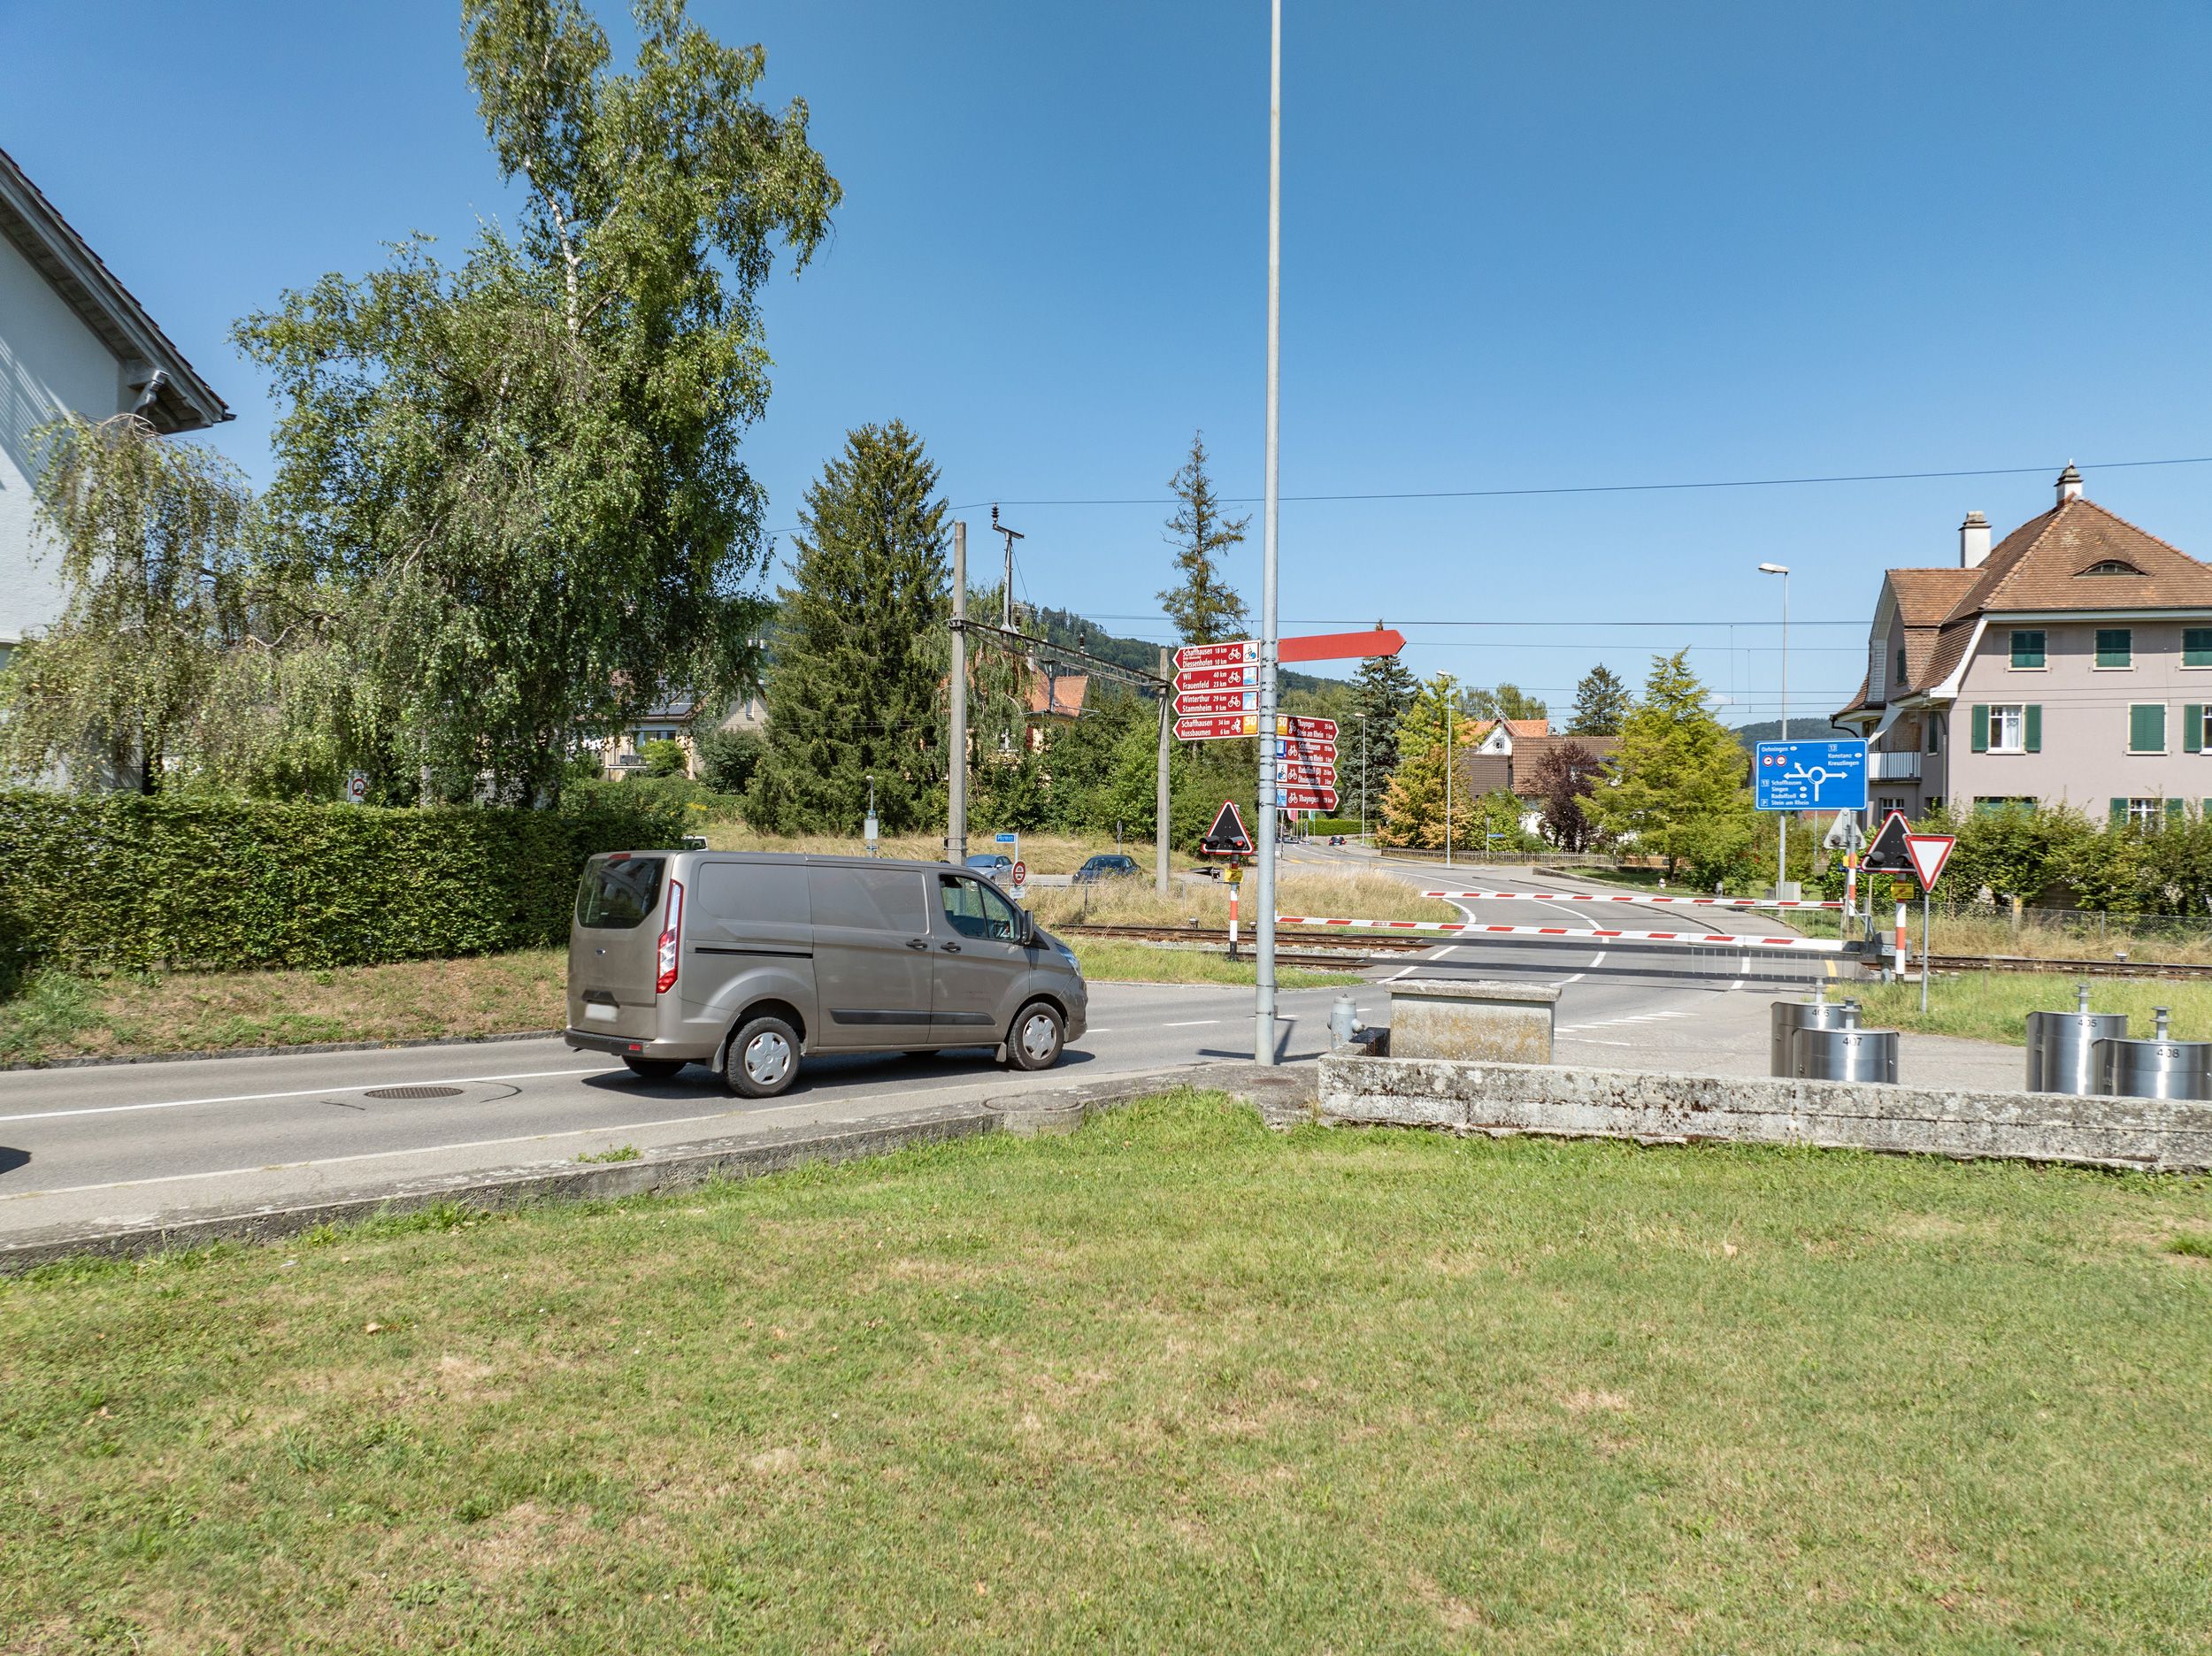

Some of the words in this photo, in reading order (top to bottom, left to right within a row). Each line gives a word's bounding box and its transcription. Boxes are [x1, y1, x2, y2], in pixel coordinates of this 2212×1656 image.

[1182, 648, 1213, 656] Schaffhausen
[1182, 658, 1213, 668] Diessenhofen
[1182, 680, 1210, 689] Frauenfeld
[1181, 719, 1213, 728] Schaffhausen
[1244, 716, 1257, 725] 50
[1279, 717, 1287, 727] 50
[1297, 718, 1315, 730] Thayngen
[1279, 745, 1284, 754] 2
[1298, 741, 1321, 750] Schaffhausen
[1299, 794, 1319, 804] Thayngen
